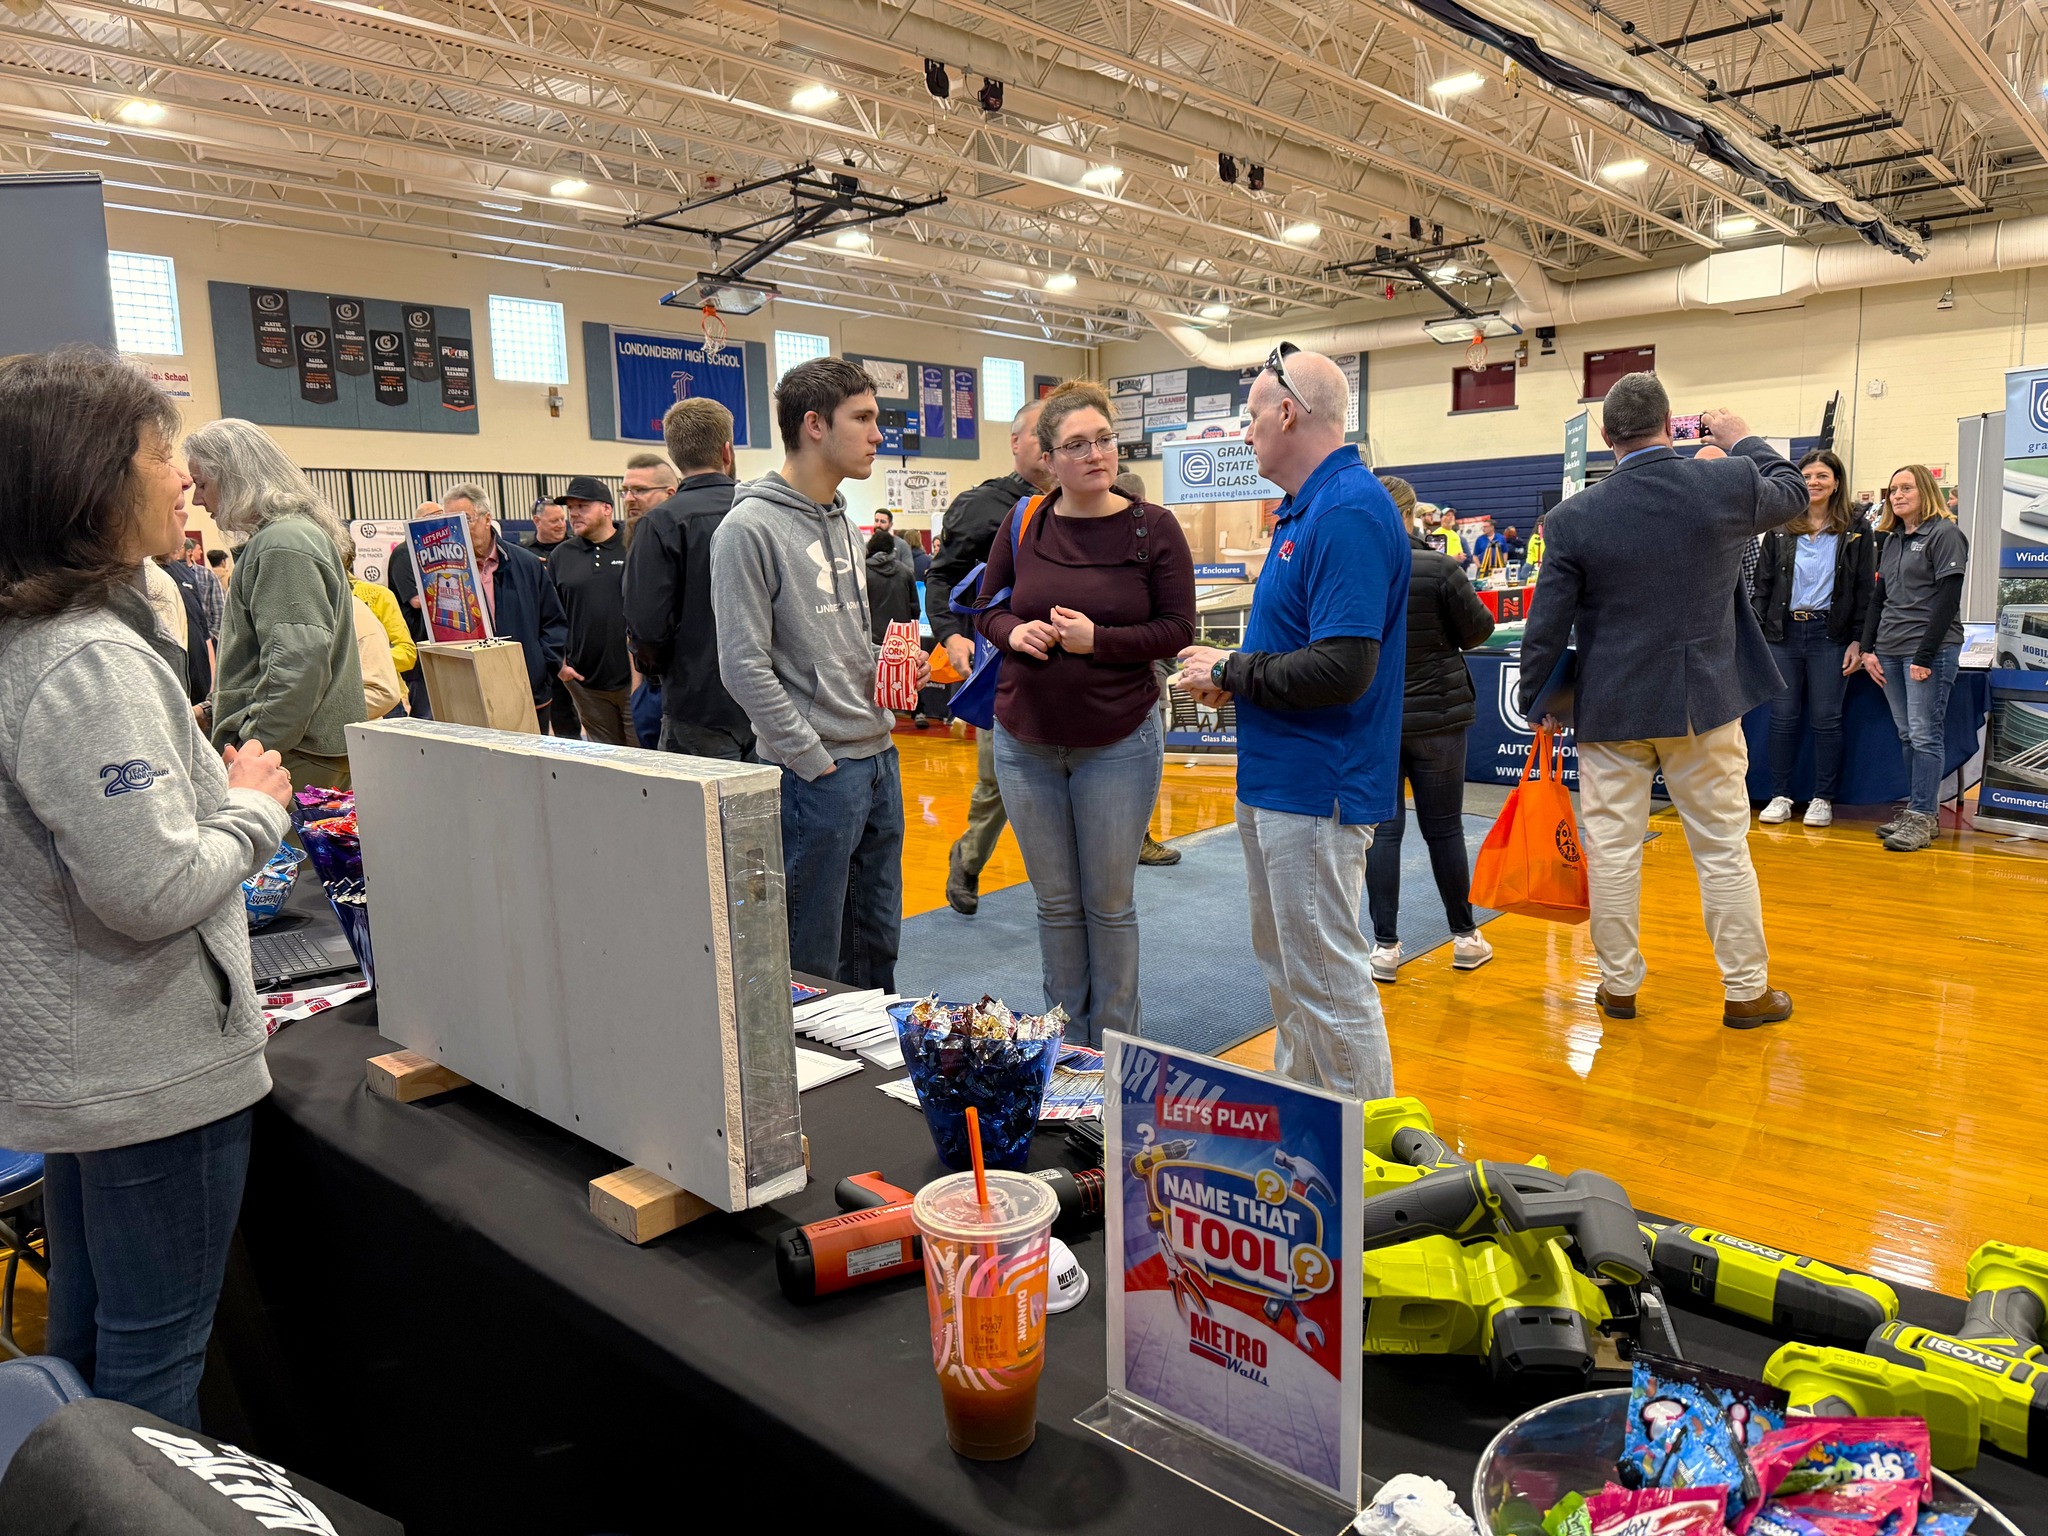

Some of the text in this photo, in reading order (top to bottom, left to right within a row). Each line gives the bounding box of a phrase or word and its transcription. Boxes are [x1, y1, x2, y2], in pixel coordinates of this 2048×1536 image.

[262, 346, 276, 354] 2010
[618, 341, 741, 368] LONDONDERRY HIGH SCHOOL
[165, 372, 189, 382] School
[1217, 460, 1254, 472] STATE
[1217, 475, 1258, 487] GLASS
[1180, 489, 1271, 501] granitestateglass.com
[423, 528, 449, 544] LET'S PLAY
[419, 543, 465, 568] PLINKO
[1203, 566, 1241, 575] Enclosures
[815, 603, 843, 614] UNDE
[886, 647, 906, 655] CORN
[1201, 734, 1220, 743] Glass
[100, 759, 153, 797] 20
[1163, 1102, 1269, 1132] LET'S PLAY
[1163, 1172, 1300, 1236] NAME THAT
[1175, 1206, 1288, 1284] TOOL
[1716, 1234, 1784, 1261] RYOBI
[1056, 1265, 1078, 1286] METRO
[1190, 1311, 1268, 1369] METRO
[1926, 1337, 2007, 1372] RYOBI
[1227, 1357, 1270, 1388] Walls
